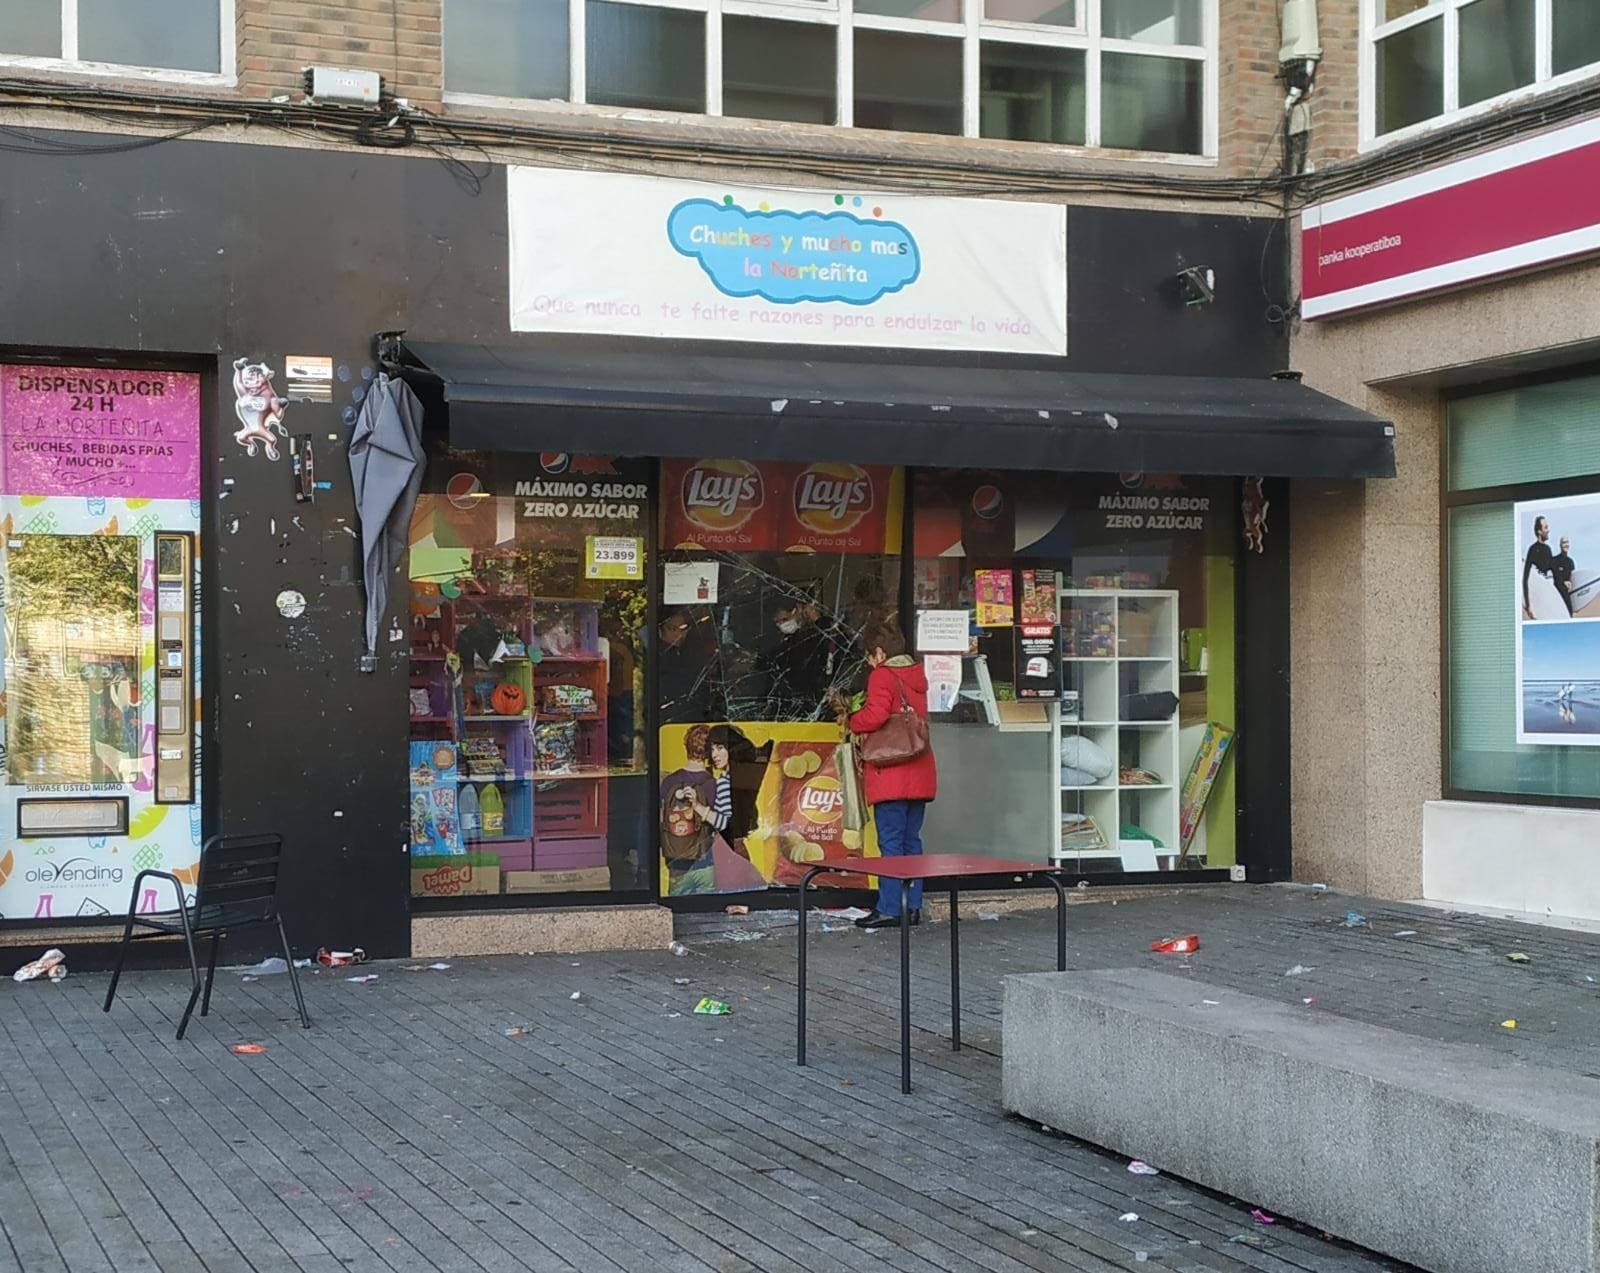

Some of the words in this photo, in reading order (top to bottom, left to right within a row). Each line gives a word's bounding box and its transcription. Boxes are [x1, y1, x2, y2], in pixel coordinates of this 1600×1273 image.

[689, 225, 772, 249] Chuches
[781, 235, 792, 254] y
[802, 233, 862, 253] mucho
[871, 239, 909, 256] mas
[1344, 234, 1401, 259] kooperatiboa
[744, 257, 761, 278] la
[771, 260, 868, 283] Norteñita
[533, 294, 575, 315] Que
[585, 300, 641, 317] nunca
[660, 302, 681, 318] te
[691, 302, 740, 322] falte
[750, 308, 824, 326] razones
[832, 312, 875, 329] para
[884, 313, 963, 332] endulzar
[971, 315, 987, 333] la
[995, 317, 1032, 336] vida
[18, 375, 165, 396] DISPENSADOR
[70, 396, 95, 412] 24
[101, 397, 114, 412] H
[21, 416, 46, 432] LA
[56, 417, 164, 436] NORTEÑITA
[12, 441, 76, 455] CHUCHES,
[82, 443, 136, 455] BEBIDAS
[54, 455, 62, 466] Y
[65, 456, 114, 468] MUCHO
[514, 476, 588, 498] MÁXIMO
[591, 483, 648, 499] SABOR
[523, 501, 569, 518] ZERO
[571, 498, 640, 519] AZÚCAR
[1098, 491, 1159, 510] MÁXIMO
[1162, 497, 1210, 511] SABOR
[1105, 514, 1144, 529] ZERO
[1146, 511, 1203, 530] AZÚCAR
[686, 533, 696, 543] Al
[697, 533, 723, 543] Punto
[724, 534, 736, 543] de
[738, 534, 752, 544] Sal
[798, 536, 808, 545] Al
[809, 536, 833, 546] Punto
[834, 537, 847, 546] de
[848, 537, 862, 547] Sal
[595, 550, 635, 560] 23.899
[26, 784, 61, 793] SIRVASE
[63, 783, 91, 792] USTED
[92, 782, 123, 792] MISMO
[423, 864, 472, 889] Damel
